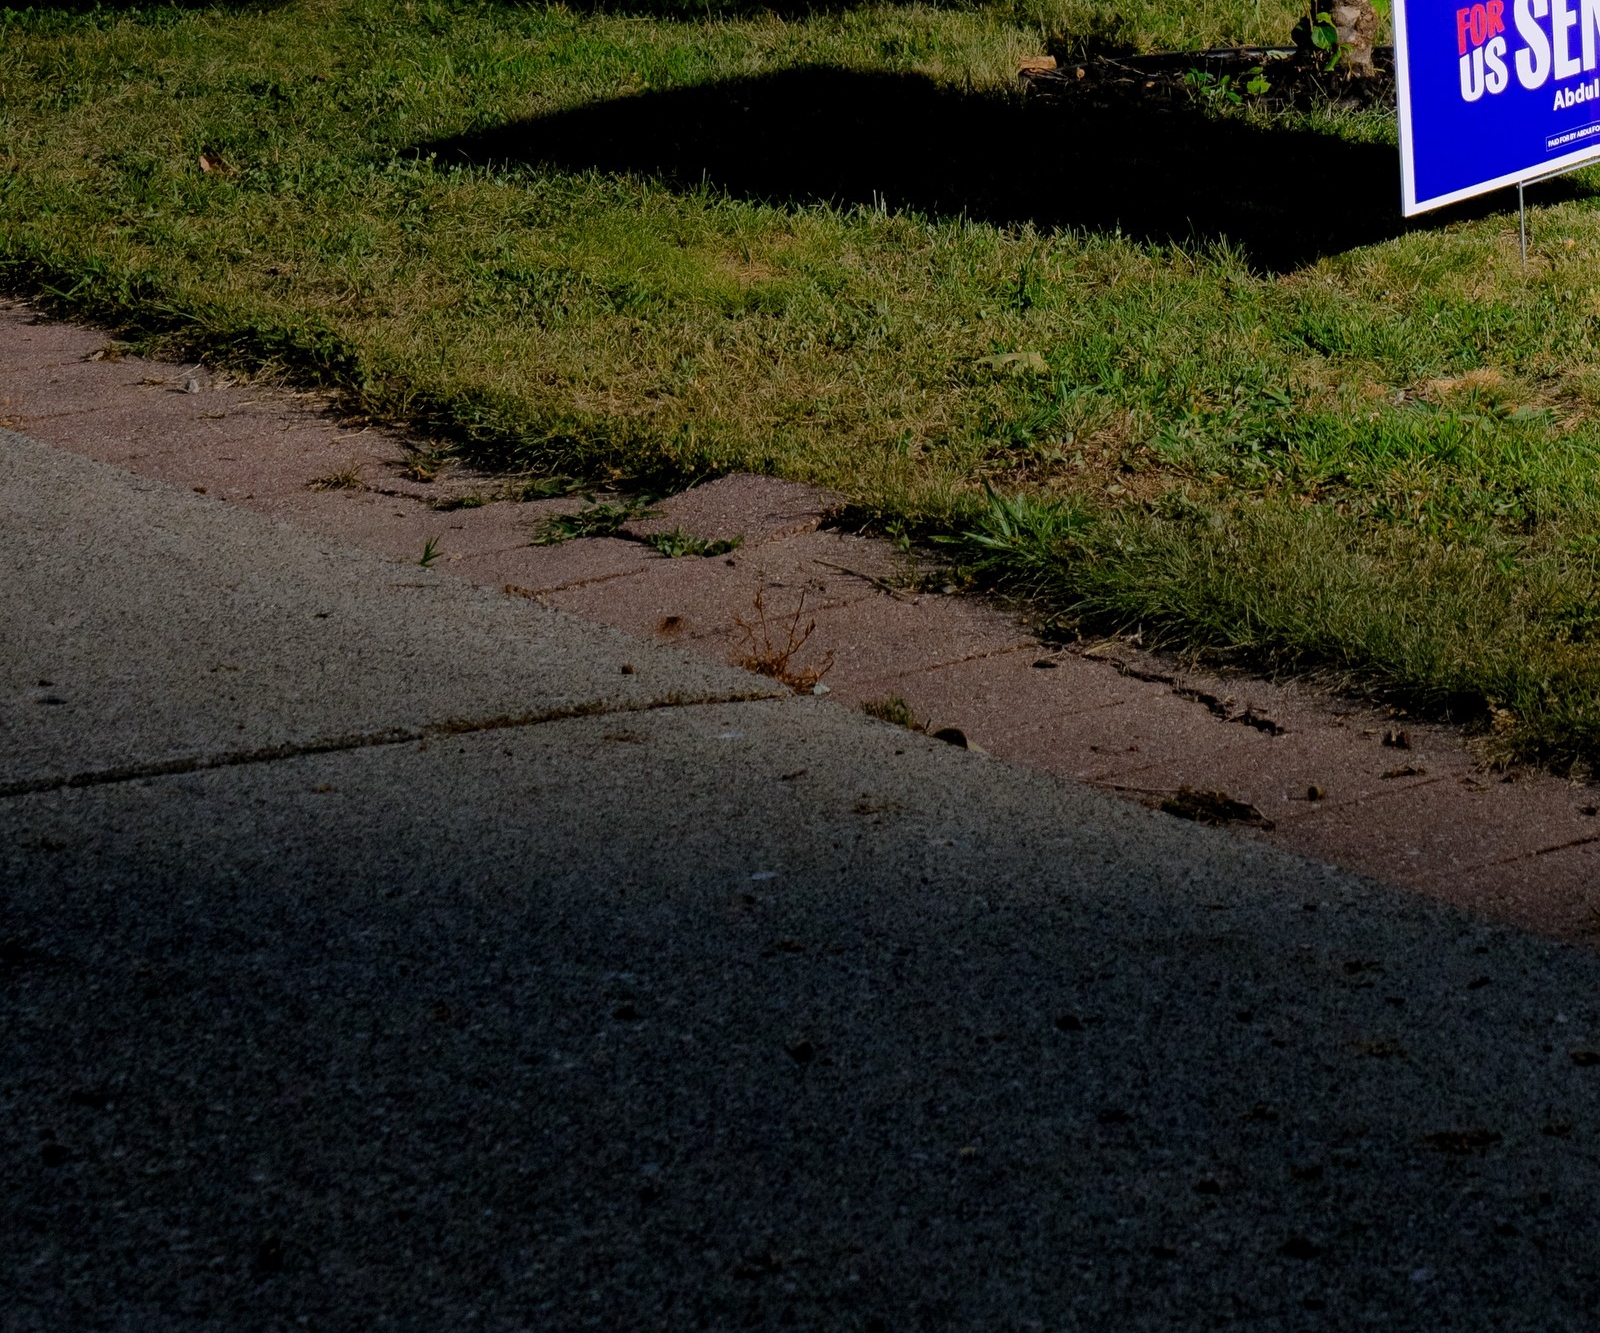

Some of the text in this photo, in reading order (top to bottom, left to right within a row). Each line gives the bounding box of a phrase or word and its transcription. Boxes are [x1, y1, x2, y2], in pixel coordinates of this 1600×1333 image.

[1457, 0, 1505, 55] FOR
[1459, 36, 1508, 102] US
[1547, 138, 1560, 148] PAID
[1559, 135, 1570, 144] FOR
[1569, 132, 1577, 140] BY
[1576, 128, 1592, 138] ABDUL
